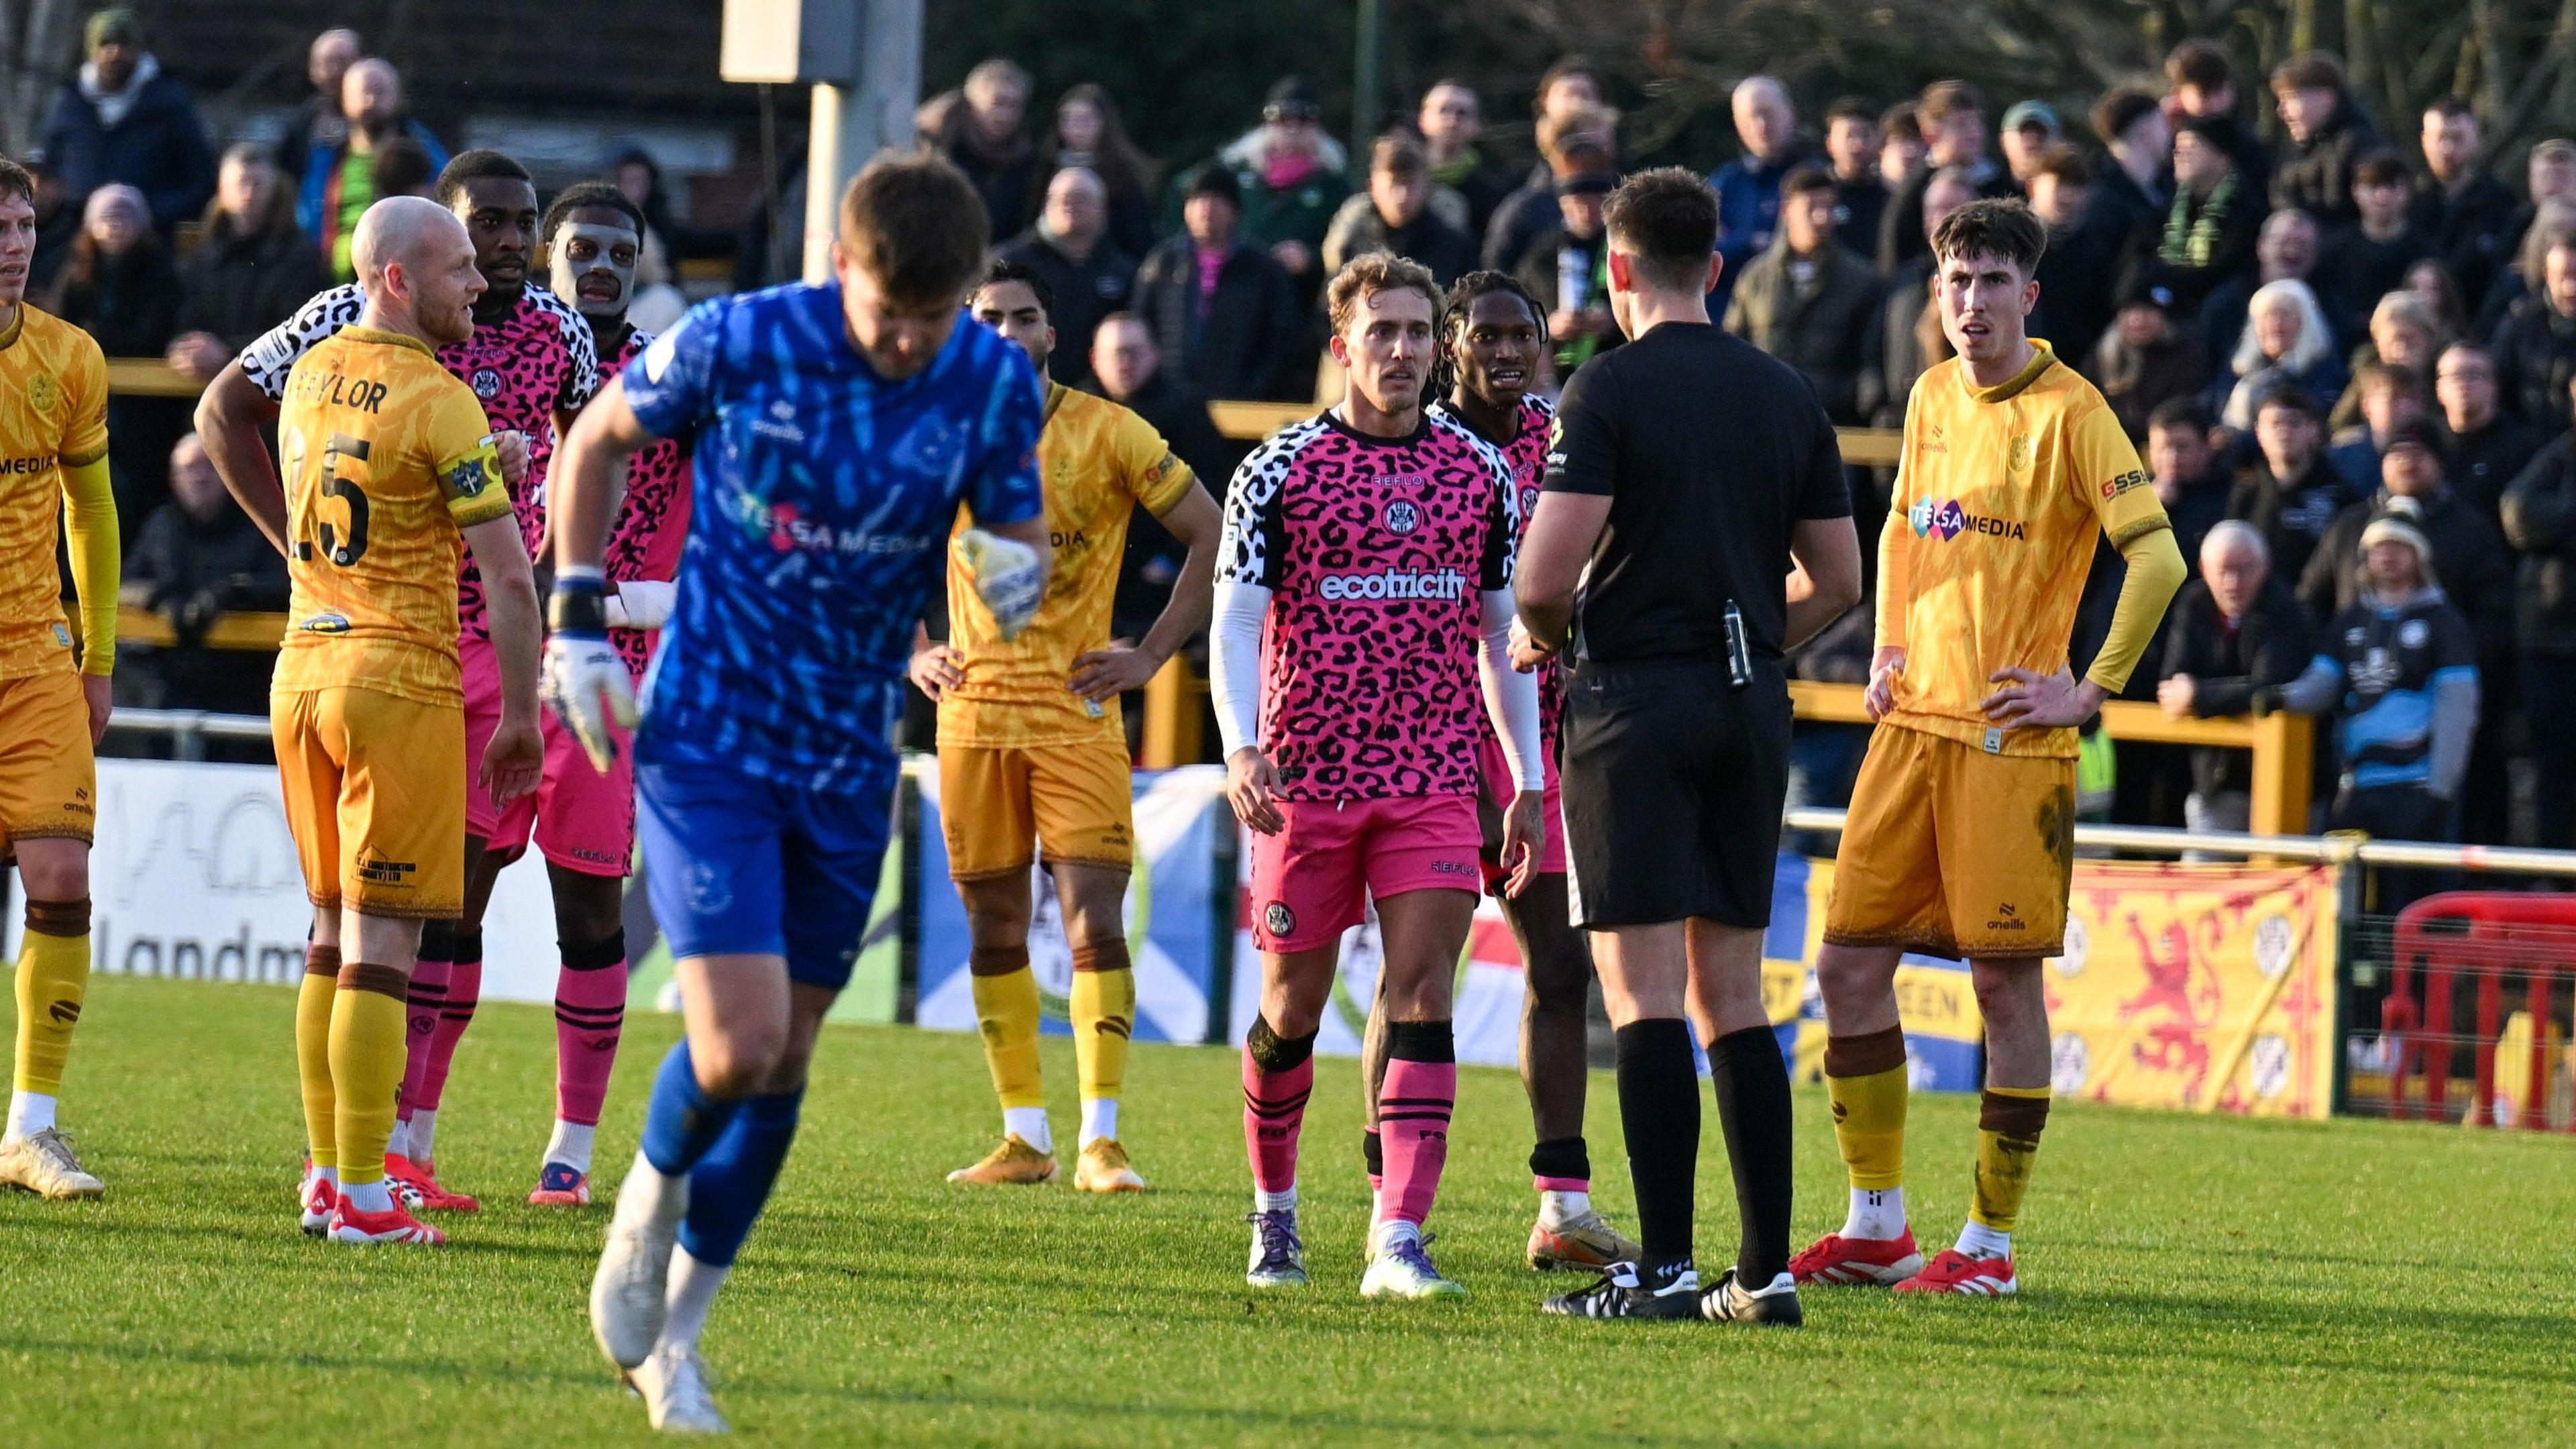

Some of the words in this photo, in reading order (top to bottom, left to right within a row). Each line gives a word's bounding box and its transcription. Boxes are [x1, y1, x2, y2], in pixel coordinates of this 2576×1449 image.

[295, 370, 387, 414] AYLOR
[1373, 476, 1423, 486] REFLO
[1051, 530, 1085, 547] DIA
[1912, 505, 1962, 530] TELSA
[1965, 514, 2024, 541] MEDIA
[1319, 567, 1466, 607] ecotricity
[1432, 861, 1476, 877] REFLO
[1987, 919, 2025, 930] oneills
[98, 919, 307, 981] landm
[1898, 975, 1960, 1018] EEN
